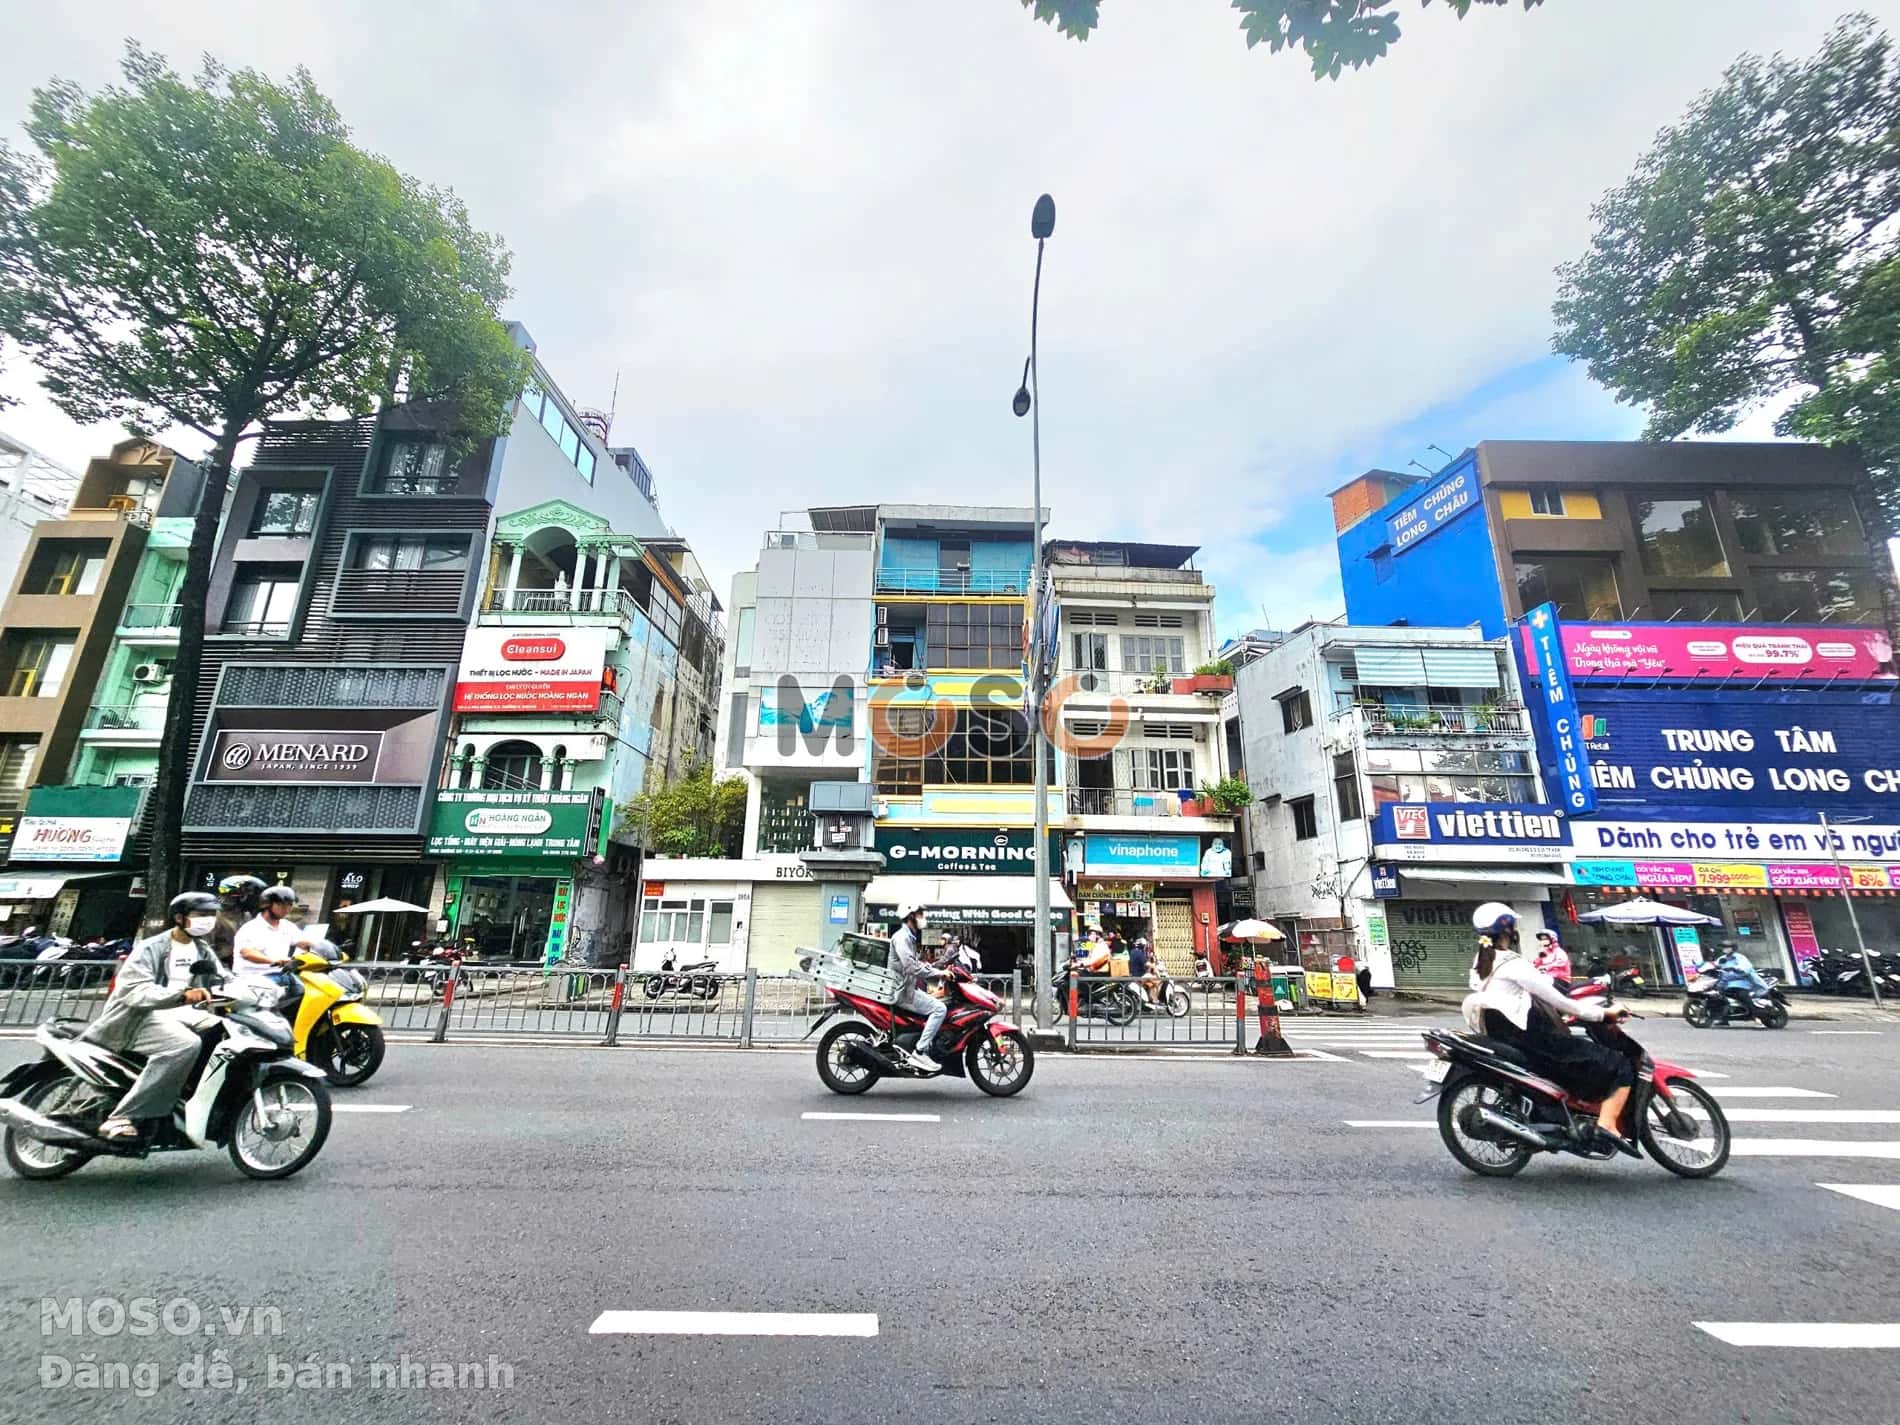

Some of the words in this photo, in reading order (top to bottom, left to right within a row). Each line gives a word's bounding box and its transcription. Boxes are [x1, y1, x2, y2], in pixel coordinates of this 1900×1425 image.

[1393, 508, 1417, 530] TIÊM
[1423, 476, 1465, 510] CHỦNG
[1396, 520, 1428, 547] LONG
[1435, 491, 1468, 520] CHÂU
[507, 643, 557, 654] Cleansui
[1765, 650, 1799, 658] 99.7%
[496, 669, 511, 677] LỌC
[540, 668, 560, 676] MADE
[1540, 636, 1564, 704] TIÊM
[1556, 719, 1585, 807] CHỦNG
[1661, 729, 1754, 752] TRUNG
[1774, 726, 1837, 752] TÂM
[255, 743, 369, 762] MENARD
[1650, 758, 1755, 790] CHỦNG
[1768, 768, 1851, 792] LONG
[1397, 809, 1425, 820] VTEC
[1436, 810, 1561, 838] viettien
[1597, 827, 1662, 849] Dành
[1671, 828, 1716, 850] cho
[1725, 826, 1759, 850] trẻ
[1769, 832, 1807, 850] em
[1108, 843, 1179, 859] vinaphone
[1671, 873, 1694, 884] HPV
[991, 910, 1022, 919] Good
